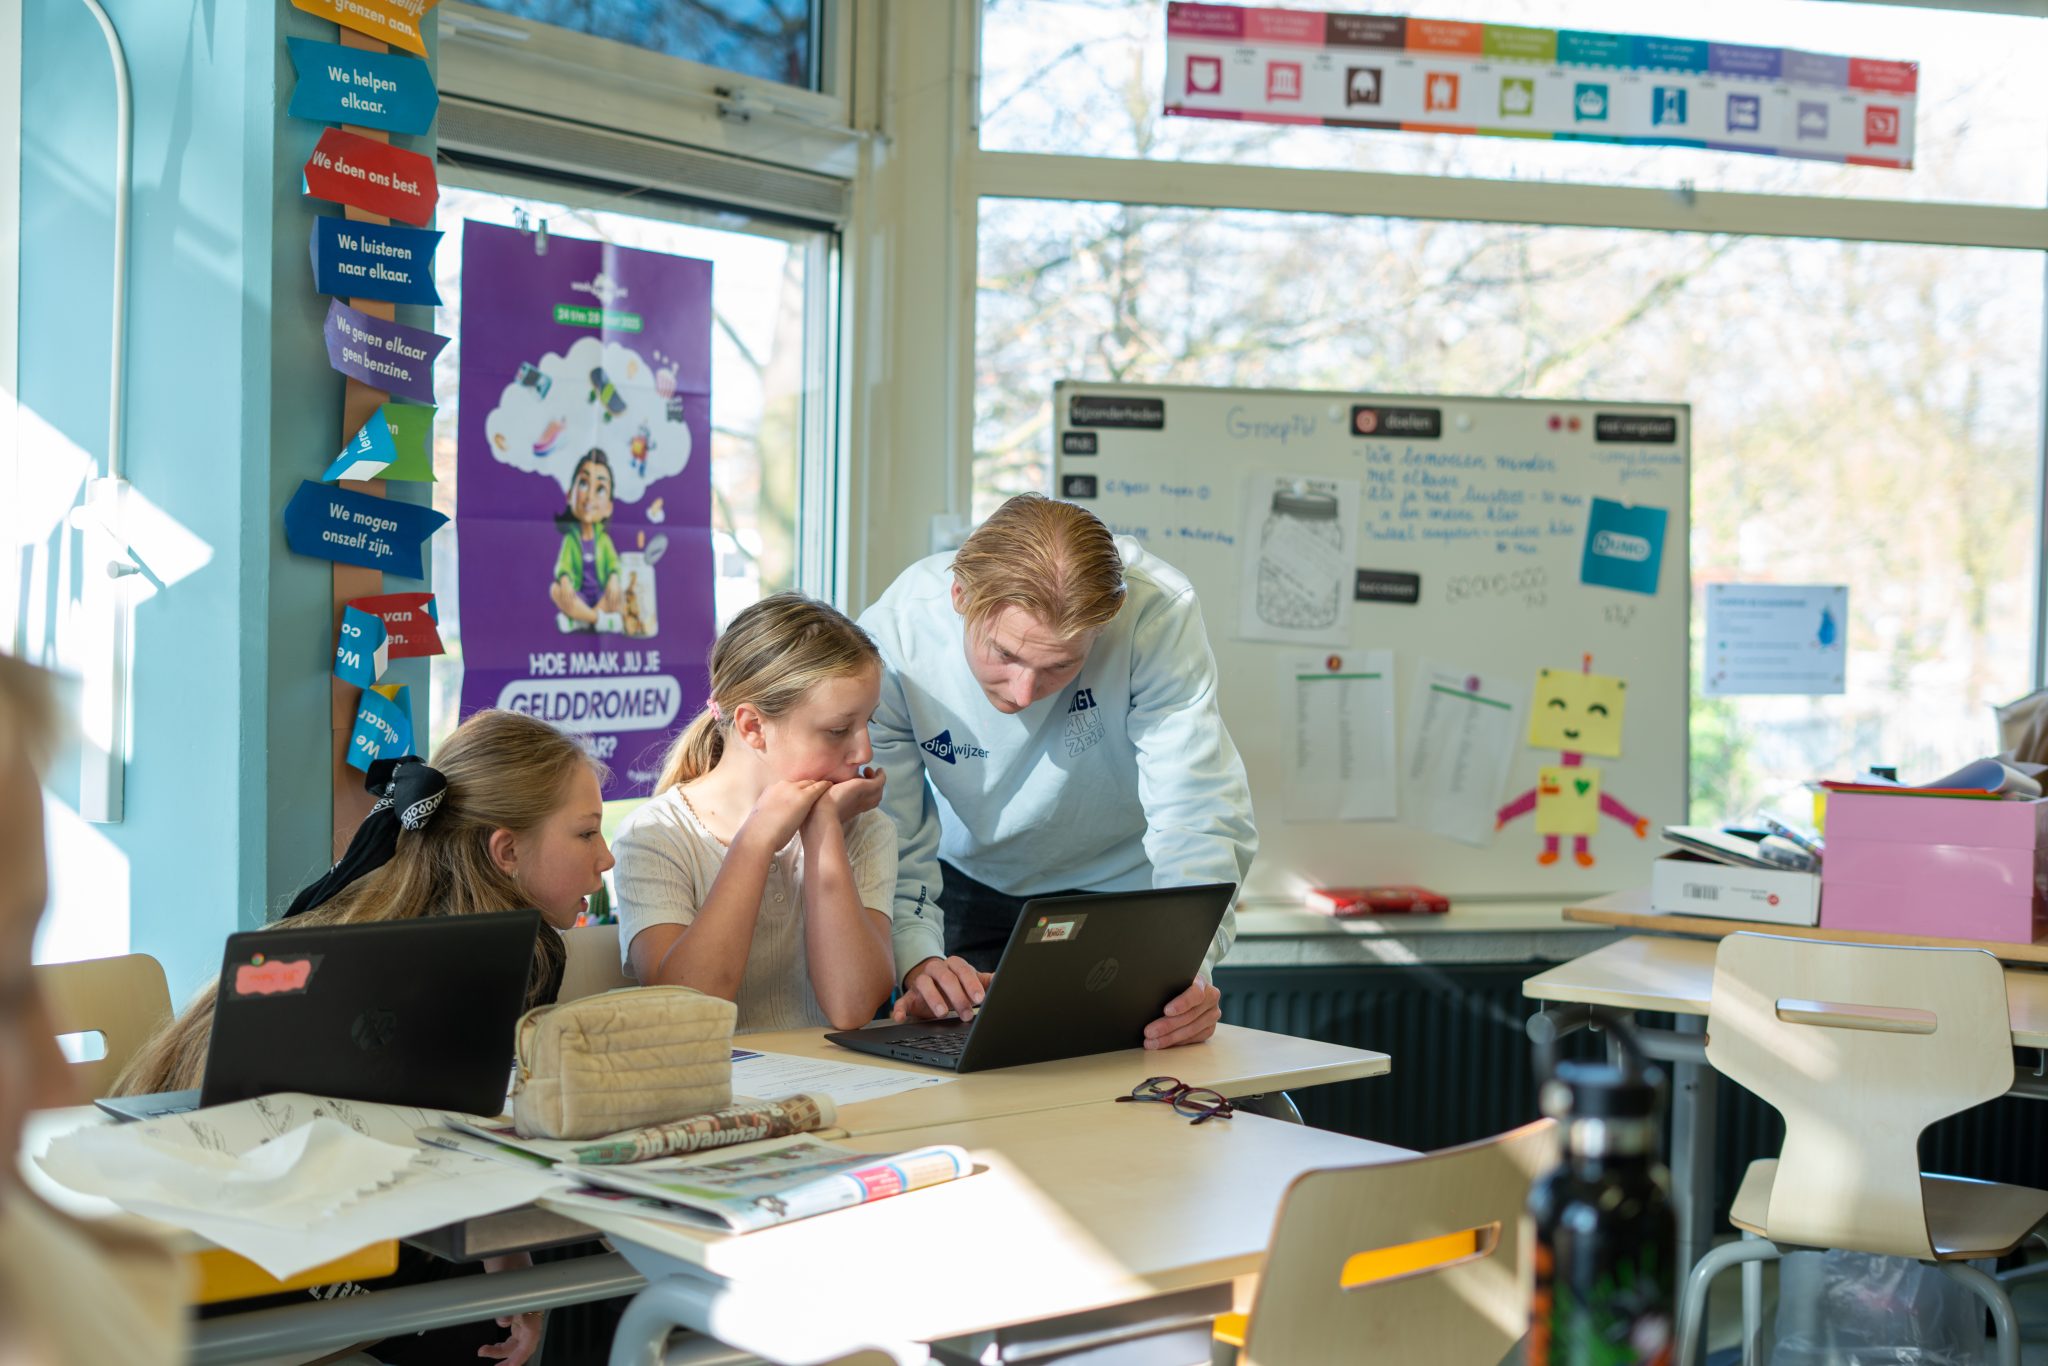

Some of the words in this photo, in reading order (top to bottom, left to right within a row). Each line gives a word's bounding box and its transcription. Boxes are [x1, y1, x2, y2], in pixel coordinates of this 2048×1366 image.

[335, 0, 385, 25] grenzen
[388, 18, 416, 37] aan.
[328, 66, 350, 83] We
[354, 69, 397, 93] helpen
[341, 92, 387, 114] elkaar.
[312, 151, 331, 169] We
[334, 157, 366, 180] doen
[368, 171, 390, 187] ons
[392, 175, 421, 196] best.
[337, 233, 358, 251] We
[361, 236, 412, 260] luisteren
[338, 262, 366, 275] naar
[369, 263, 412, 284] elkaar.
[336, 314, 351, 335] We
[352, 327, 382, 349] geven
[385, 336, 427, 361] elkaar
[342, 347, 362, 365] geen
[364, 352, 412, 382] benzine.
[330, 502, 350, 520] We
[353, 512, 398, 533] mogen
[322, 529, 366, 549] onszelf
[368, 539, 393, 558] zijn.
[383, 611, 412, 622] van
[337, 647, 360, 669] We
[529, 652, 567, 676] HOE
[569, 651, 619, 674] MAAK
[643, 651, 661, 673] JE
[510, 687, 670, 721] GELDDROMEN
[358, 709, 399, 744] elkaar
[355, 734, 381, 759] We
[668, 1123, 768, 1153] Myanmar
